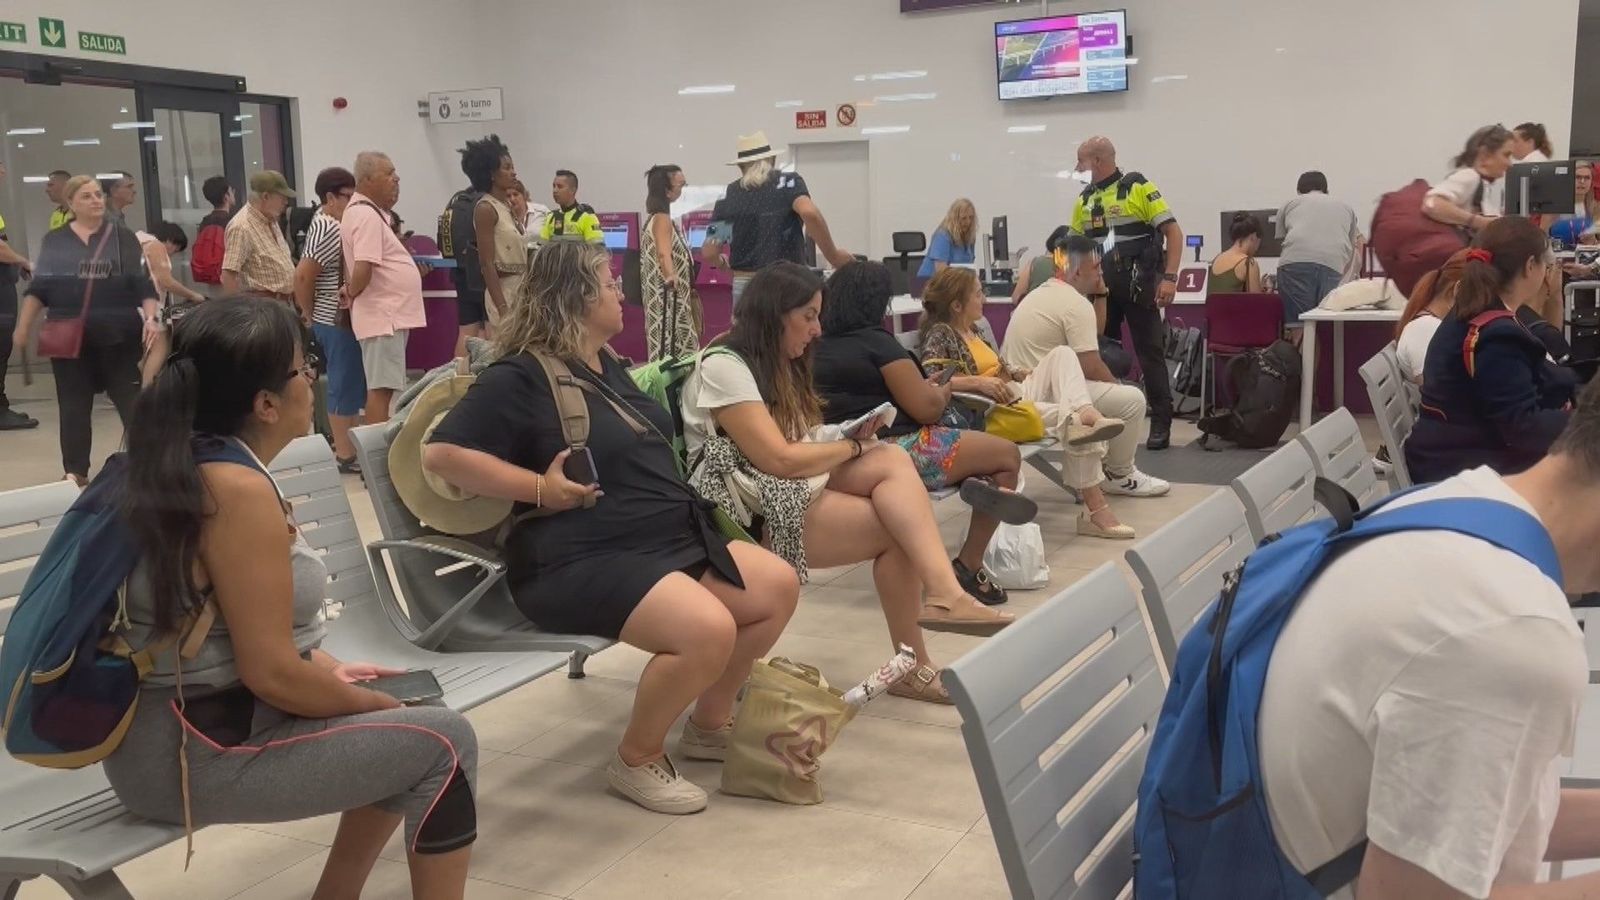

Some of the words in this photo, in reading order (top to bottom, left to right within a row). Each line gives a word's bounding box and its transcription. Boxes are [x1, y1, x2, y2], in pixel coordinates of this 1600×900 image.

[0, 25, 23, 40] IT
[81, 34, 124, 53] SALIDA
[459, 100, 469, 109] Su
[470, 99, 492, 108] turno
[797, 119, 825, 127] SALIDA
[1186, 273, 1196, 288] 1
